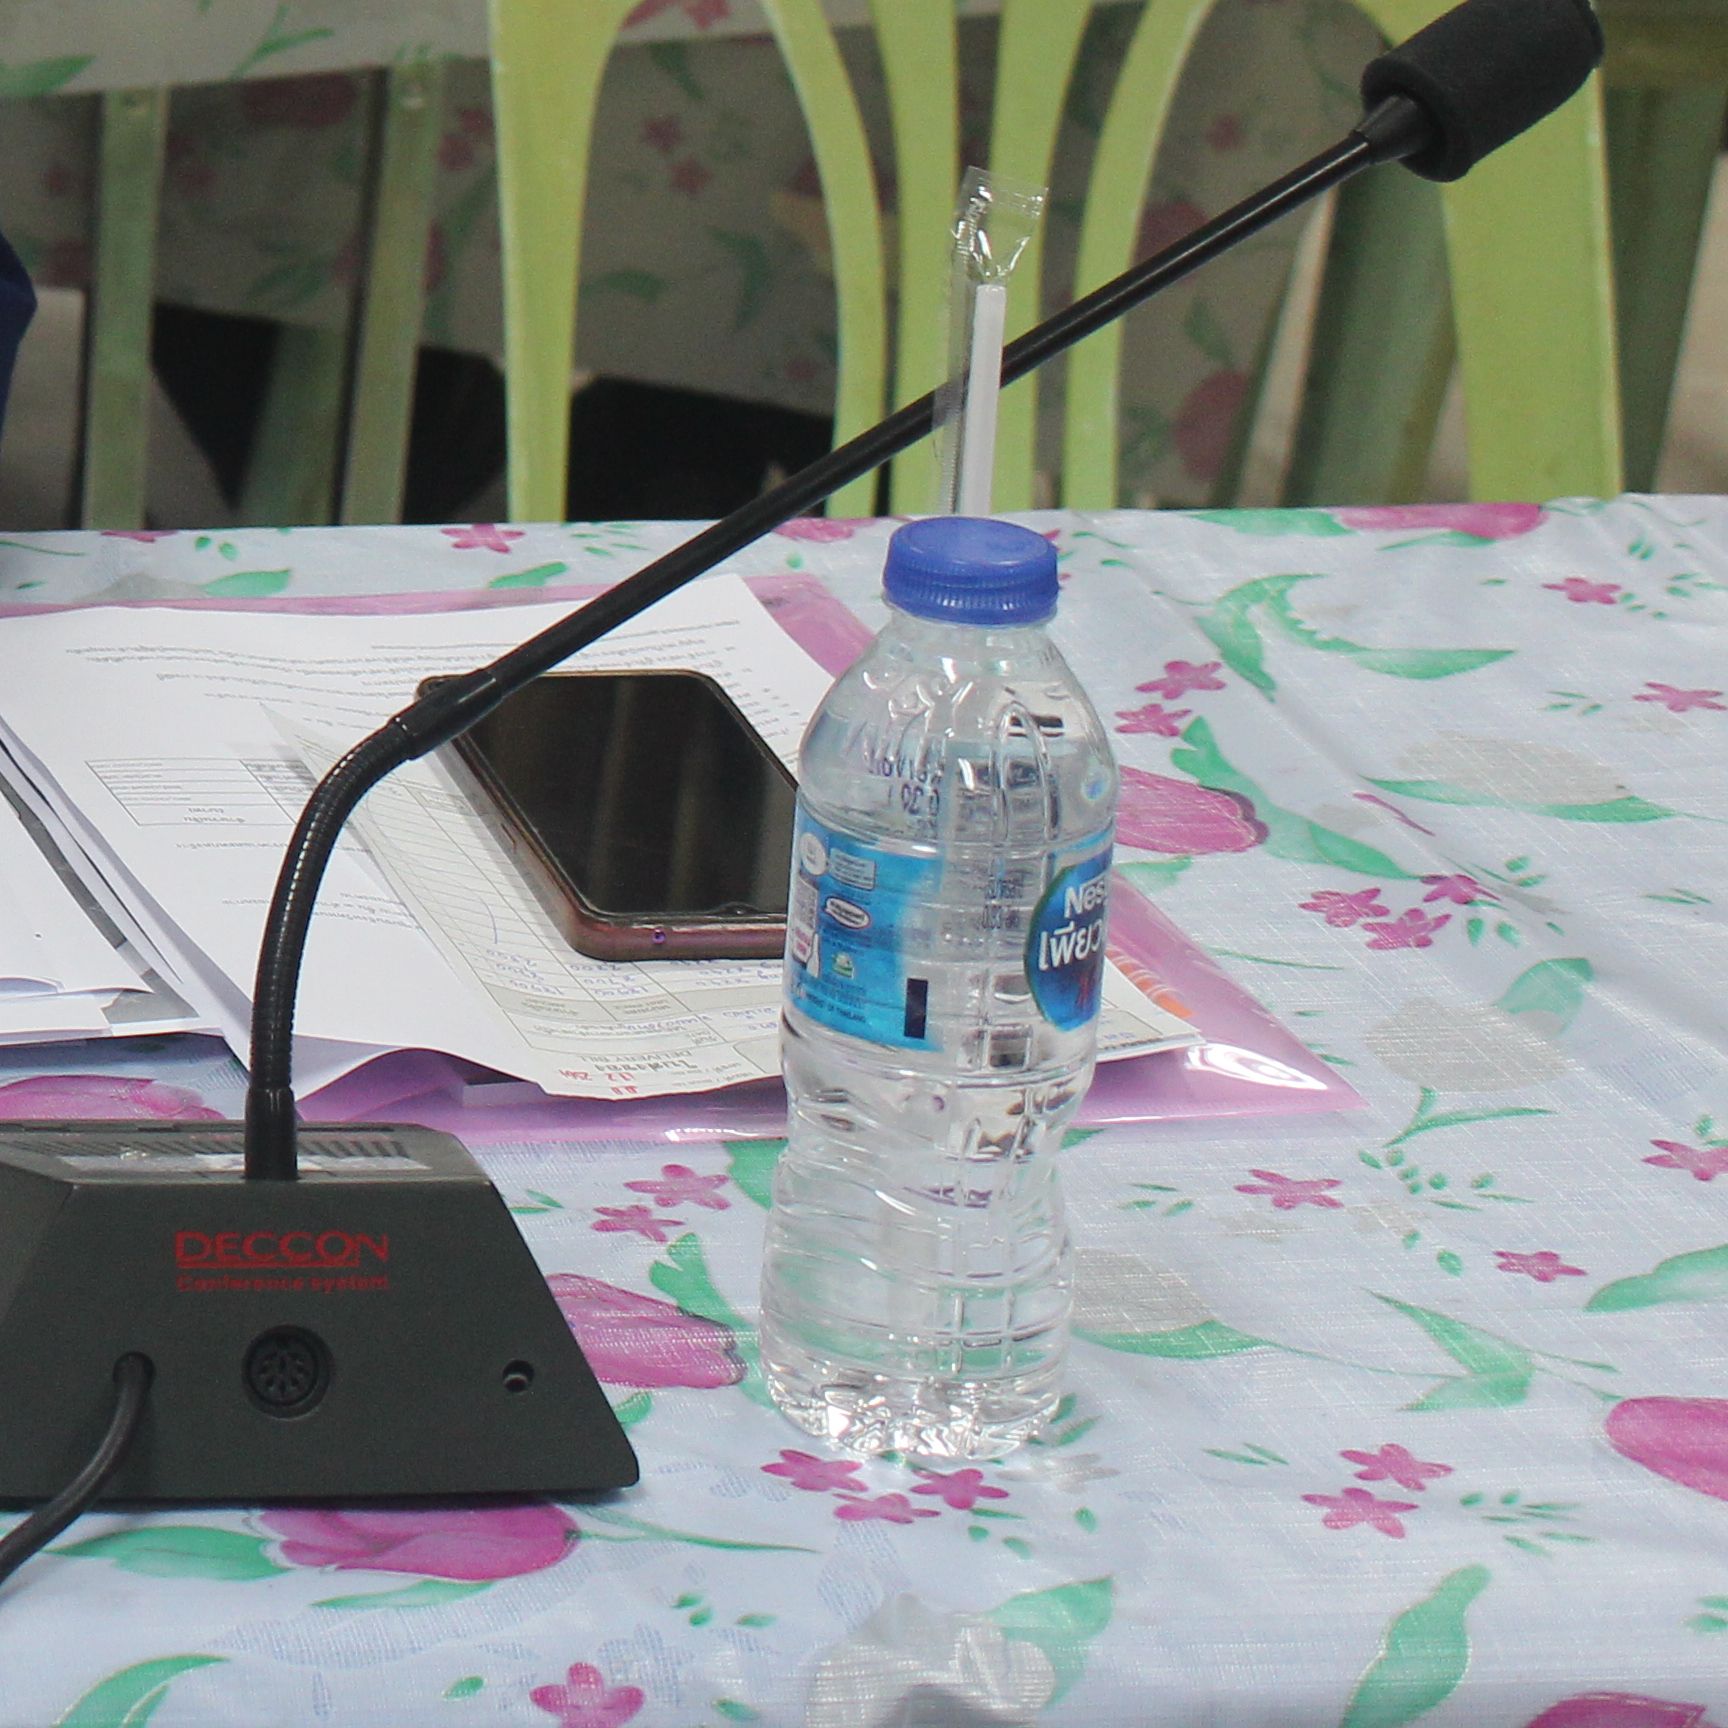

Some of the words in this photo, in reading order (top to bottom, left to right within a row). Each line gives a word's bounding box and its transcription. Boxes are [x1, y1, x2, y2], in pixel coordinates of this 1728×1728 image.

[1063, 872, 1108, 920] Nes
[615, 1049, 693, 1062] DELIVERY
[174, 1230, 389, 1265] DECCON
[176, 1273, 305, 1292] Conference
[308, 1274, 390, 1294] system
